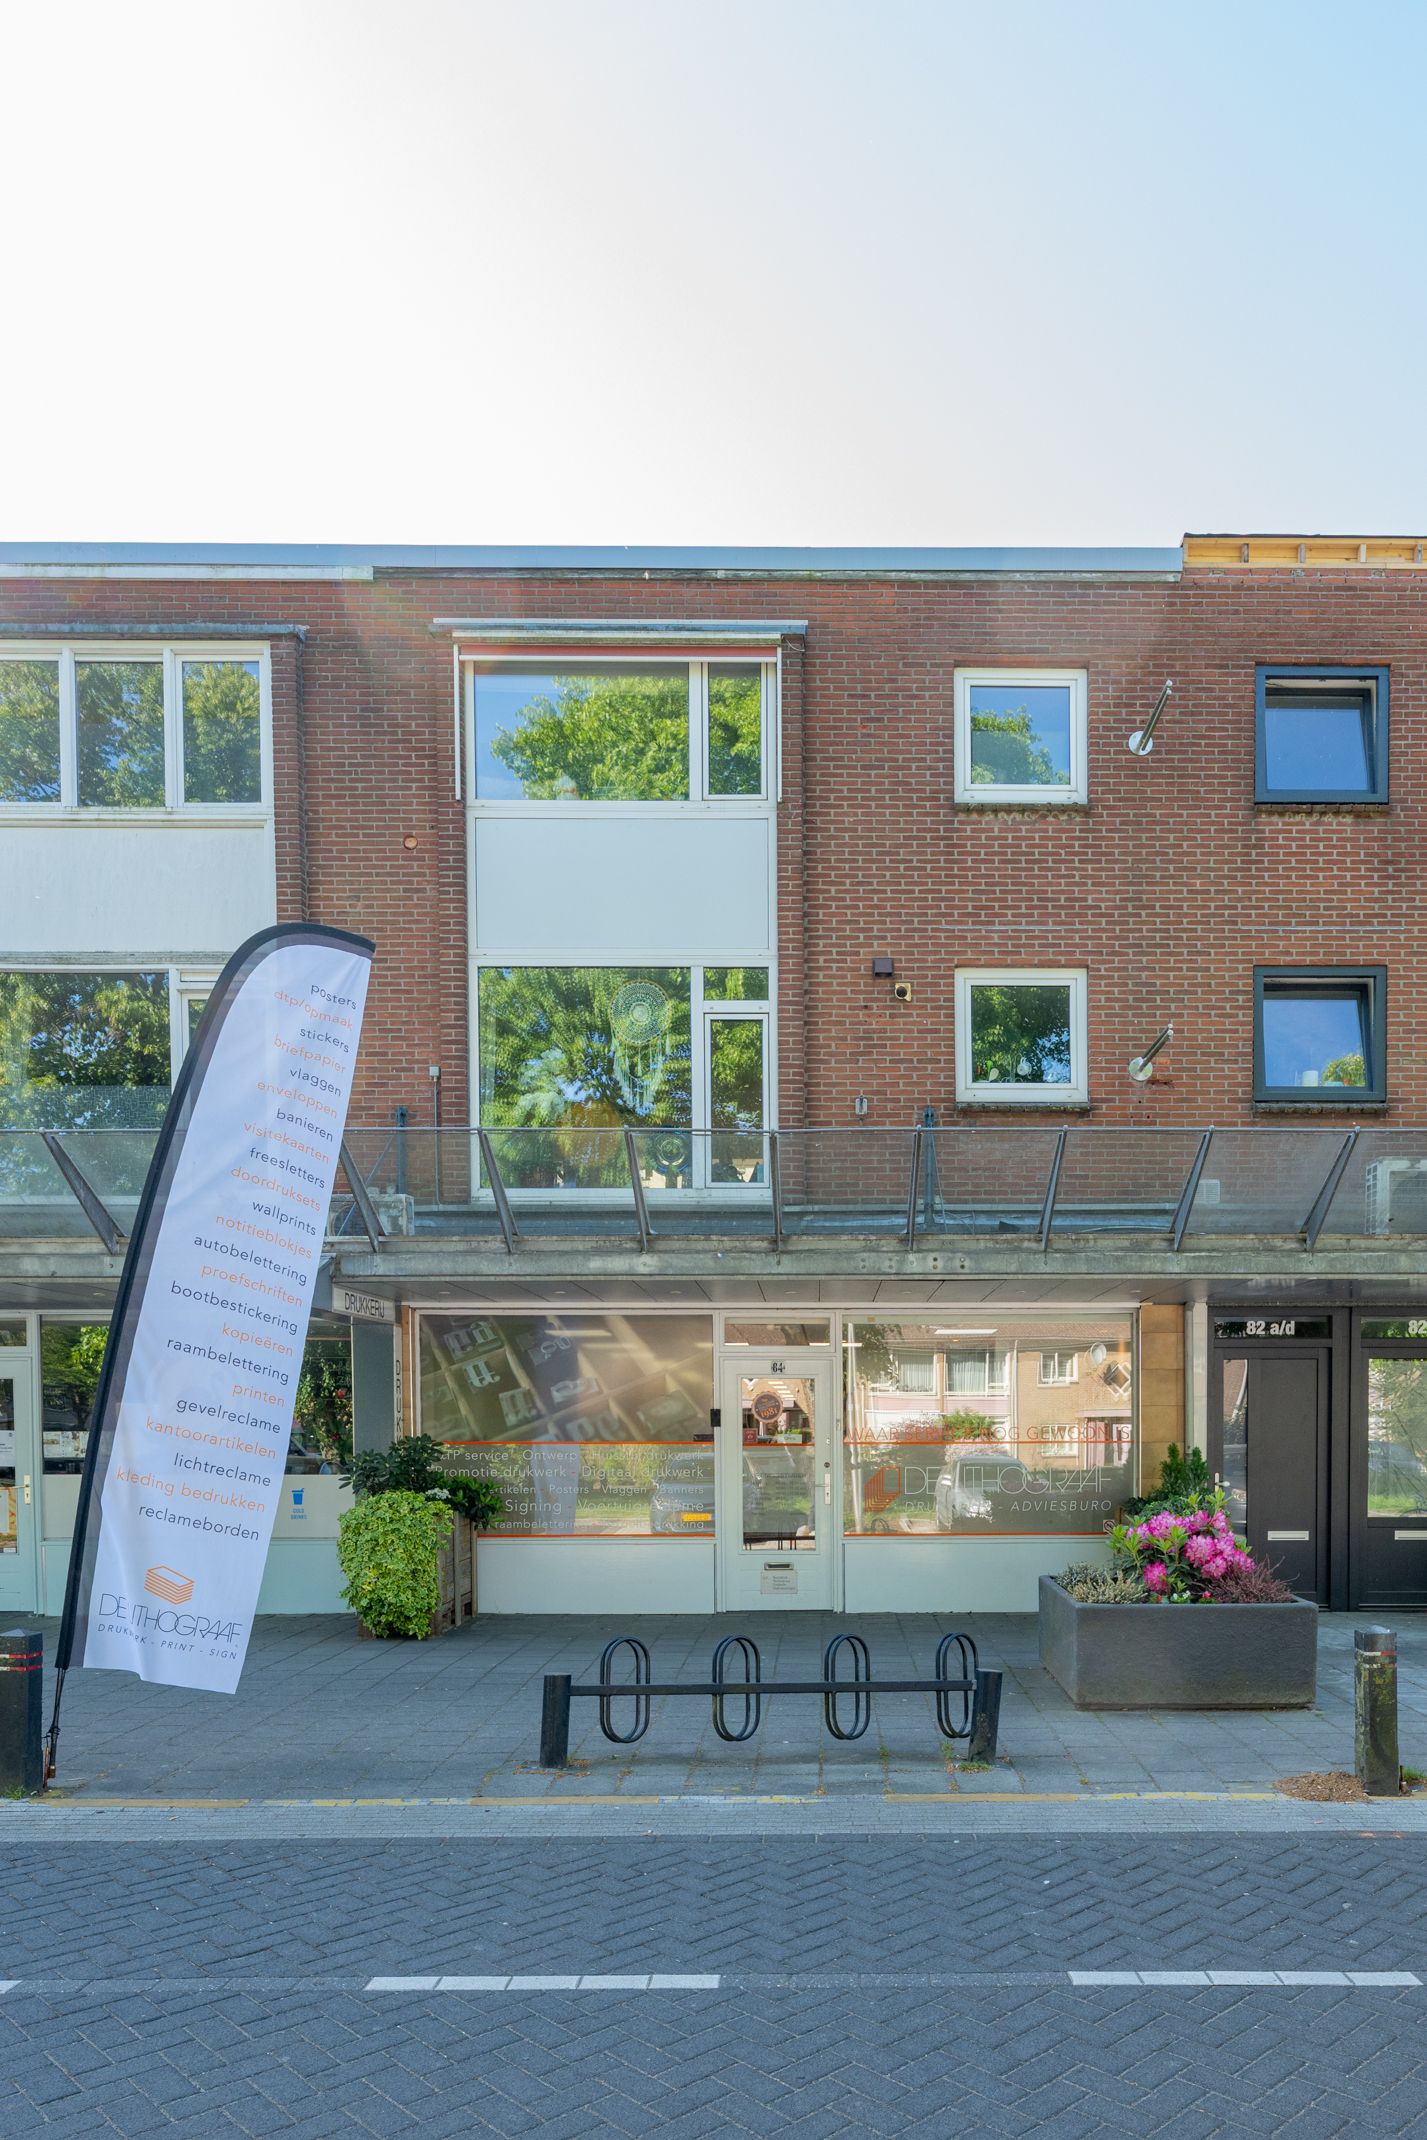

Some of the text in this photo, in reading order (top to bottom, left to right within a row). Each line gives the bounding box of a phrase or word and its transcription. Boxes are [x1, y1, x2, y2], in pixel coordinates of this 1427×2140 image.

[273, 990, 353, 1031] dtp/opmaak
[310, 984, 357, 1010] posters
[274, 1034, 346, 1073] briefpapier
[300, 1028, 350, 1053] stickers
[289, 1067, 342, 1097] vlaggen
[256, 1081, 338, 1119] enveloppen
[276, 1107, 334, 1142] banieren
[243, 1122, 331, 1164] visitekaarten
[249, 1147, 326, 1189] freesletters
[231, 1166, 321, 1212] doordruksets
[252, 1201, 316, 1236] wallprints
[215, 1215, 313, 1259] notitieblokjes
[194, 1236, 307, 1287] autobelettering
[200, 1264, 304, 1307] proefschriften
[170, 1280, 298, 1336] bootbestickering
[345, 1292, 385, 1319] DRUKKERIJ
[221, 1321, 293, 1357] kopieëren
[1246, 1320, 1295, 1335] 82 a/d
[1407, 1319, 1427, 1334] 82
[167, 1338, 289, 1386] raambelettering
[232, 1383, 286, 1408] printen
[176, 1399, 281, 1434] gevelreclame
[846, 1427, 900, 1441] WAAR
[1026, 1425, 1106, 1441] GEWOON
[145, 1416, 276, 1460] kantoorartikelen
[173, 1453, 271, 1487] lichtreclame
[464, 1450, 509, 1460] service
[522, 1449, 577, 1464] Ontwerp
[503, 1463, 567, 1478] drukwerk
[582, 1464, 635, 1480] Digitaal
[640, 1464, 704, 1478] drukwerk
[115, 1466, 266, 1514] kleding bedrukken
[549, 1484, 590, 1494] Posters
[600, 1485, 647, 1497] Vlaggen
[659, 1485, 704, 1494] Banners
[963, 1465, 1113, 1495] ITHOGRAAF
[138, 1505, 259, 1541] reclameborden
[504, 1499, 562, 1515] Signing
[1010, 1500, 1112, 1512] ADVIESBURO
[160, 1640, 195, 1652] PRINT
[209, 1648, 237, 1660] SIGN
